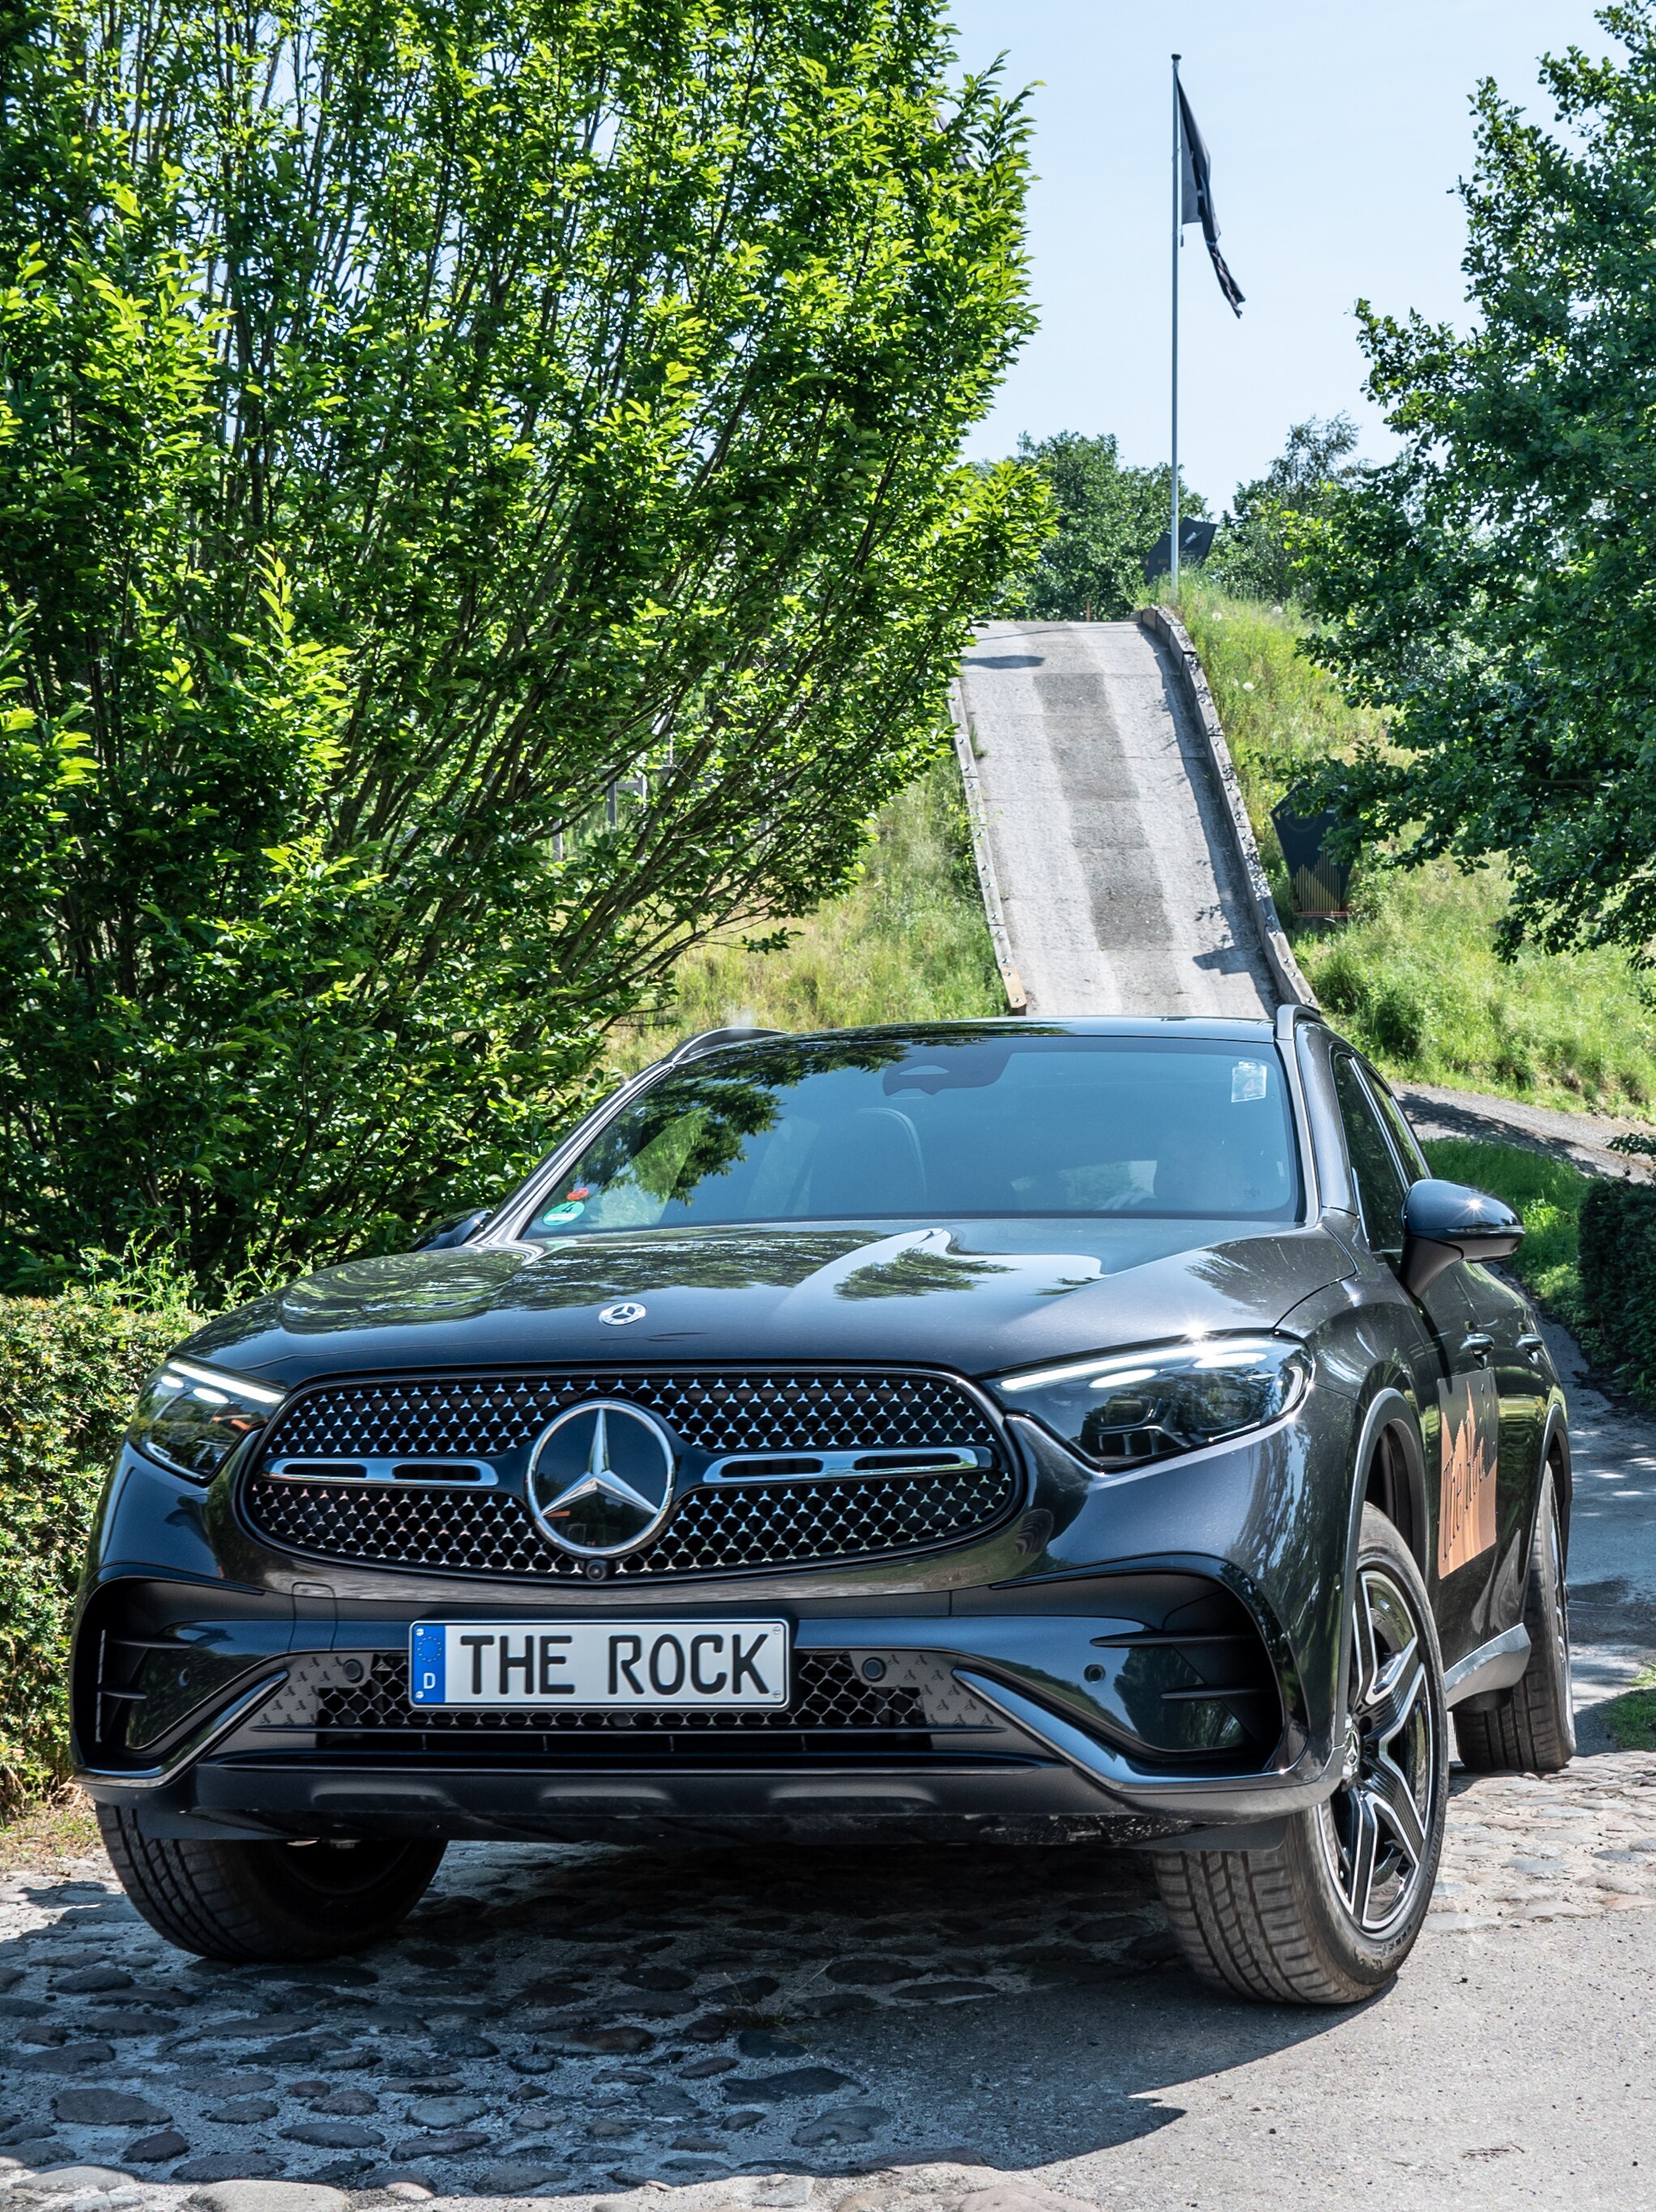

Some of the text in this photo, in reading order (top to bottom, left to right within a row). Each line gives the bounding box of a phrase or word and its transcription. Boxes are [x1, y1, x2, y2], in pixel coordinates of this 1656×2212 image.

[561, 1202, 576, 1214] 4
[459, 1633, 770, 1696] THE ROCK
[423, 1672, 437, 1689] D
